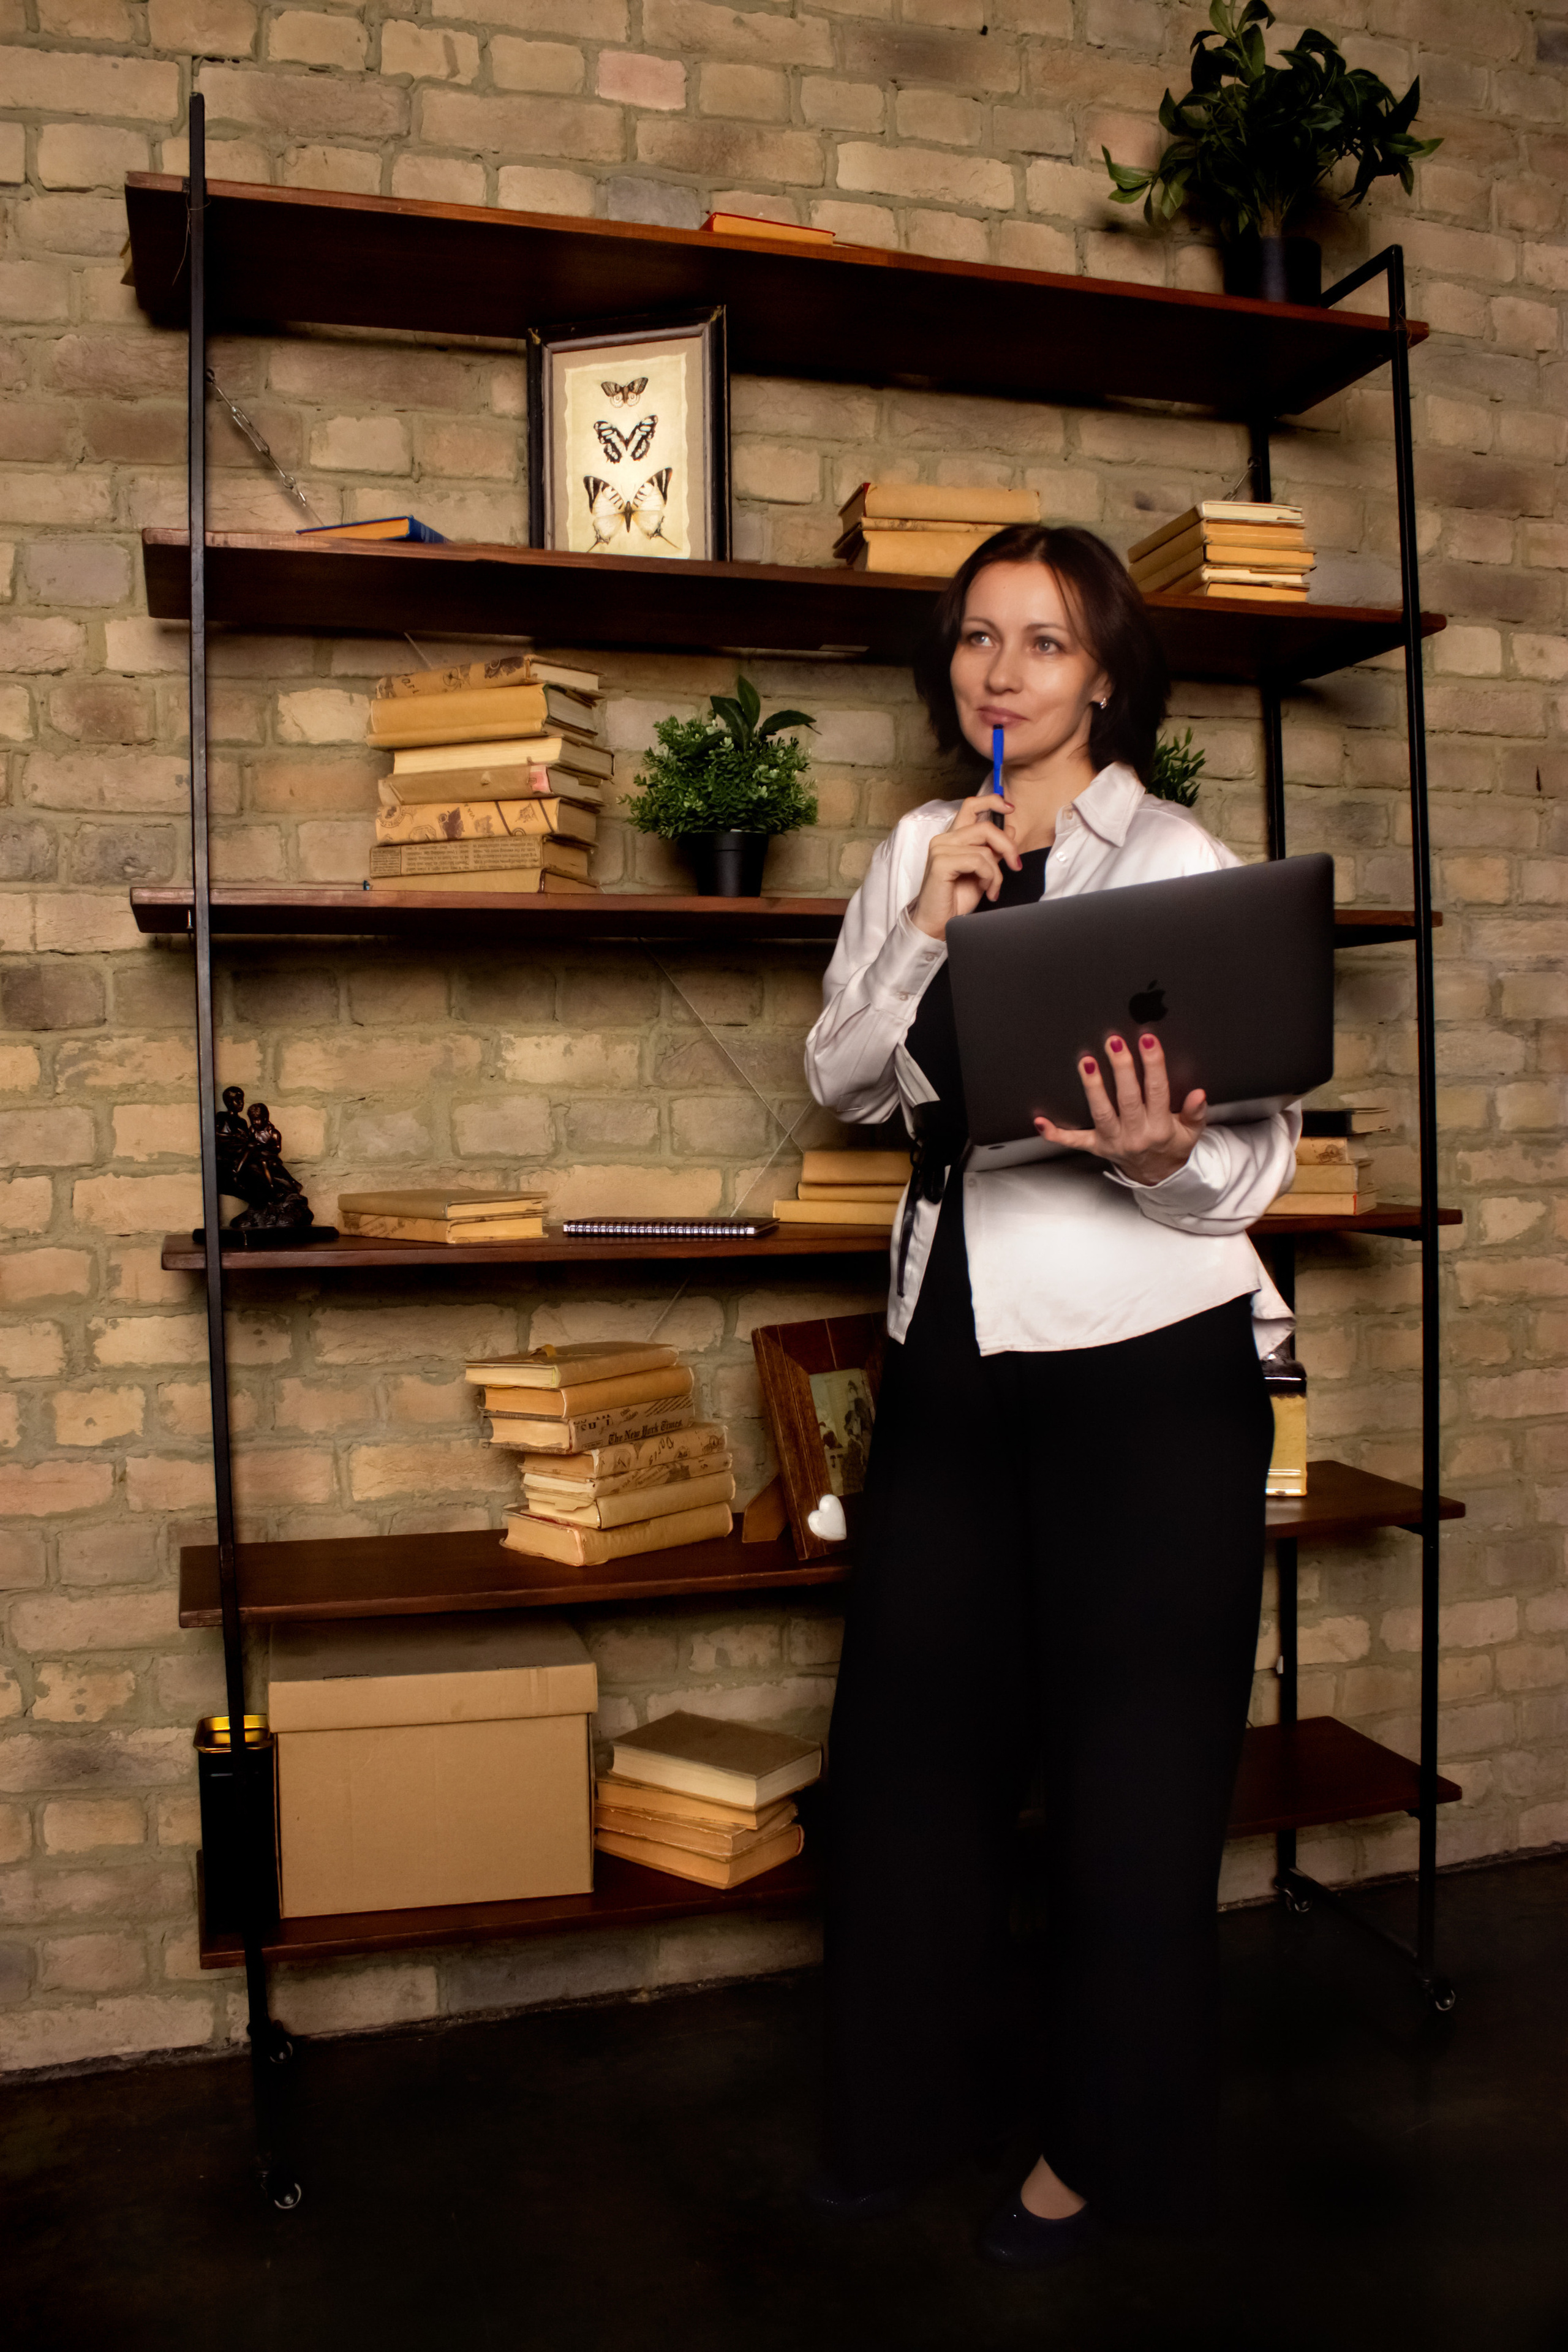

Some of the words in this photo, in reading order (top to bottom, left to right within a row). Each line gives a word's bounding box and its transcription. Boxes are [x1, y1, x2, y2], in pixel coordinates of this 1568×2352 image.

[608, 1433, 624, 1446] The
[625, 1428, 640, 1441] New
[641, 1423, 659, 1439] York
